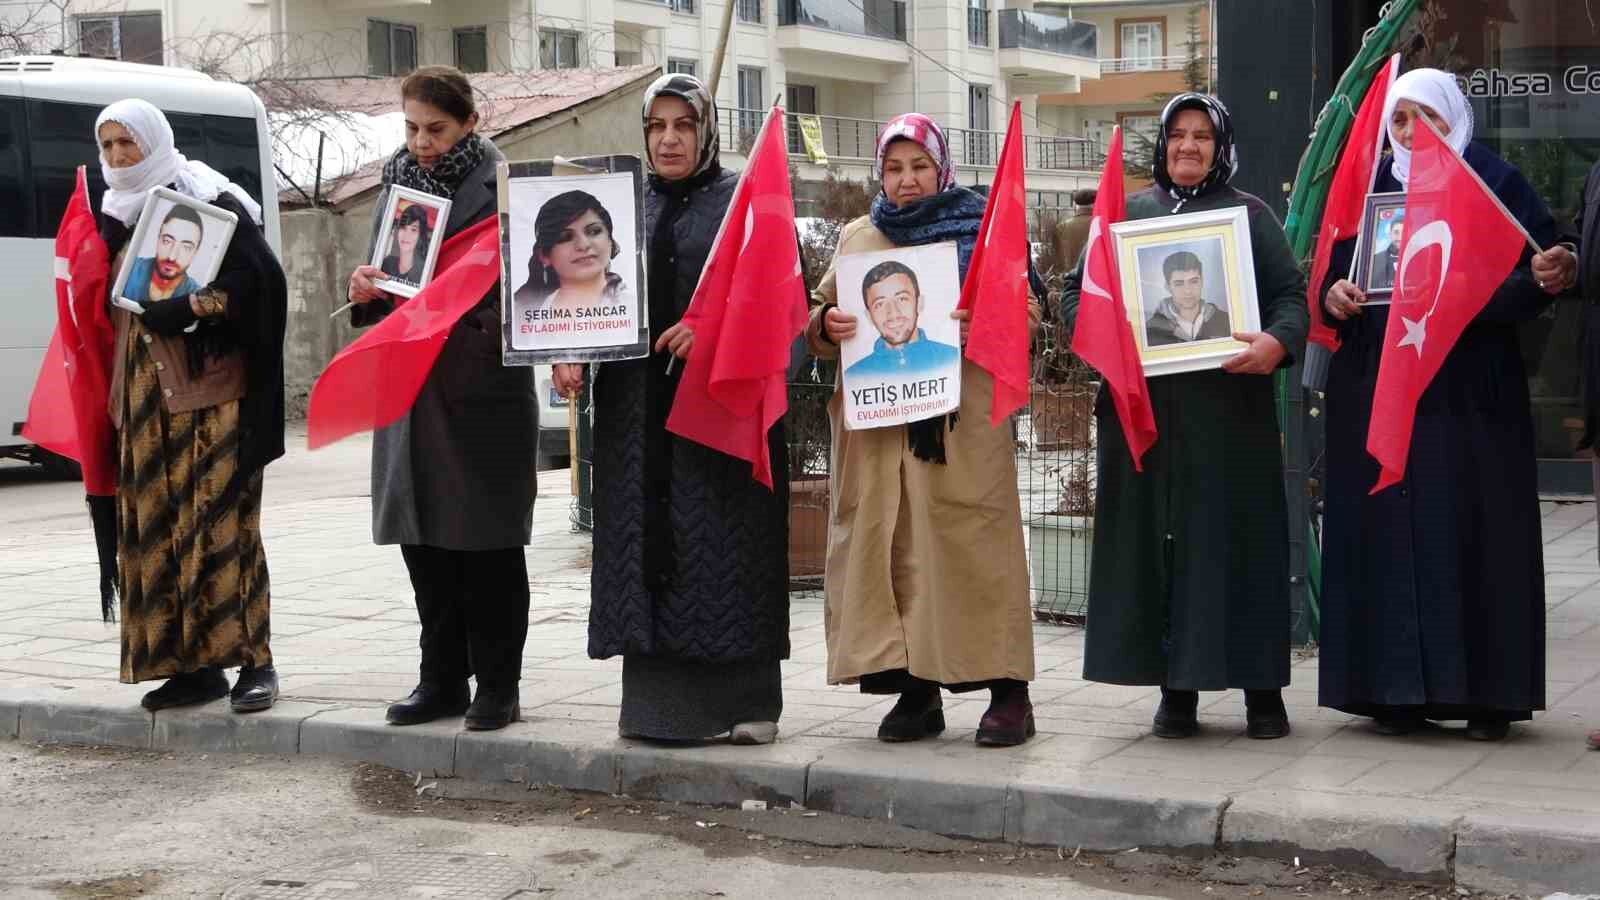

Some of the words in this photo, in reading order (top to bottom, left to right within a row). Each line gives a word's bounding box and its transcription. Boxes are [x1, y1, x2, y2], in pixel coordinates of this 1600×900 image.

[525, 307, 572, 322] ŞERİMA
[576, 305, 627, 319] SANCAR
[520, 323, 570, 334] EVLADIMI
[851, 382, 898, 406] YETİŞ
[902, 377, 947, 401] MERT
[857, 407, 899, 420] EVLADIMI
